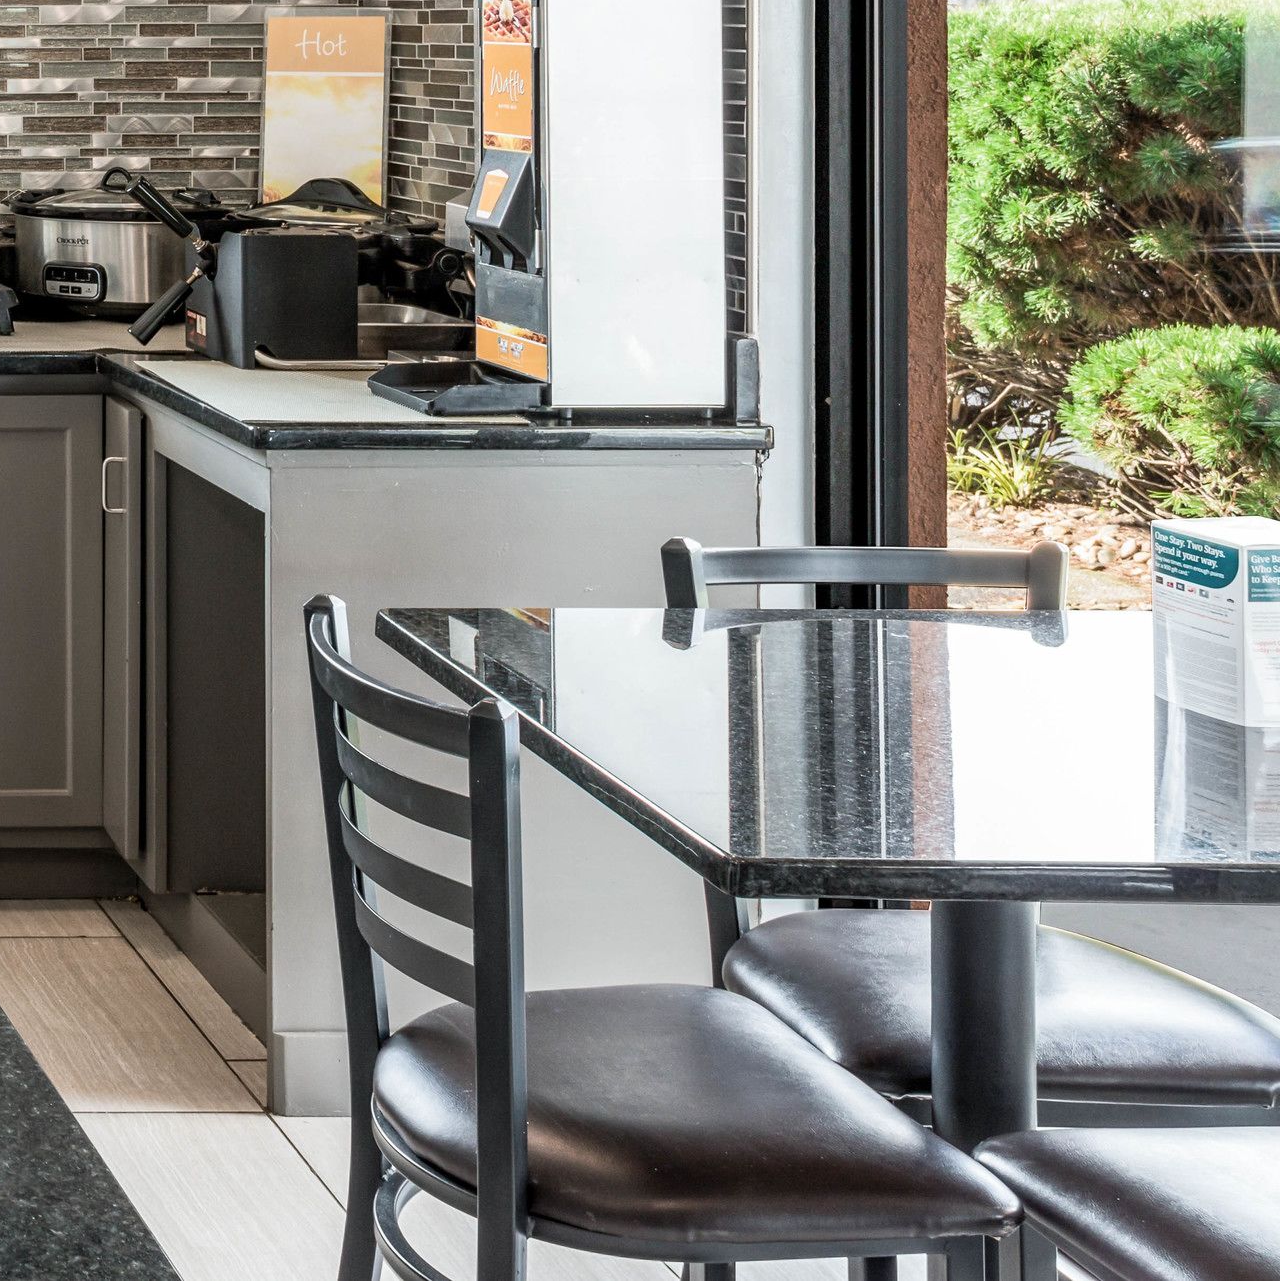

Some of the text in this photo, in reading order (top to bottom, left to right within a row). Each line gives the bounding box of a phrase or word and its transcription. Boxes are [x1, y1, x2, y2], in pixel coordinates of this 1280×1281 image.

[294, 29, 347, 59] Hot
[490, 64, 525, 102] Waffle
[1155, 531, 1225, 558] One Stay. Two Stays.
[1155, 542, 1218, 569] Spend it your way.
[1251, 555, 1270, 563] Give
[1251, 565, 1271, 573] Who
